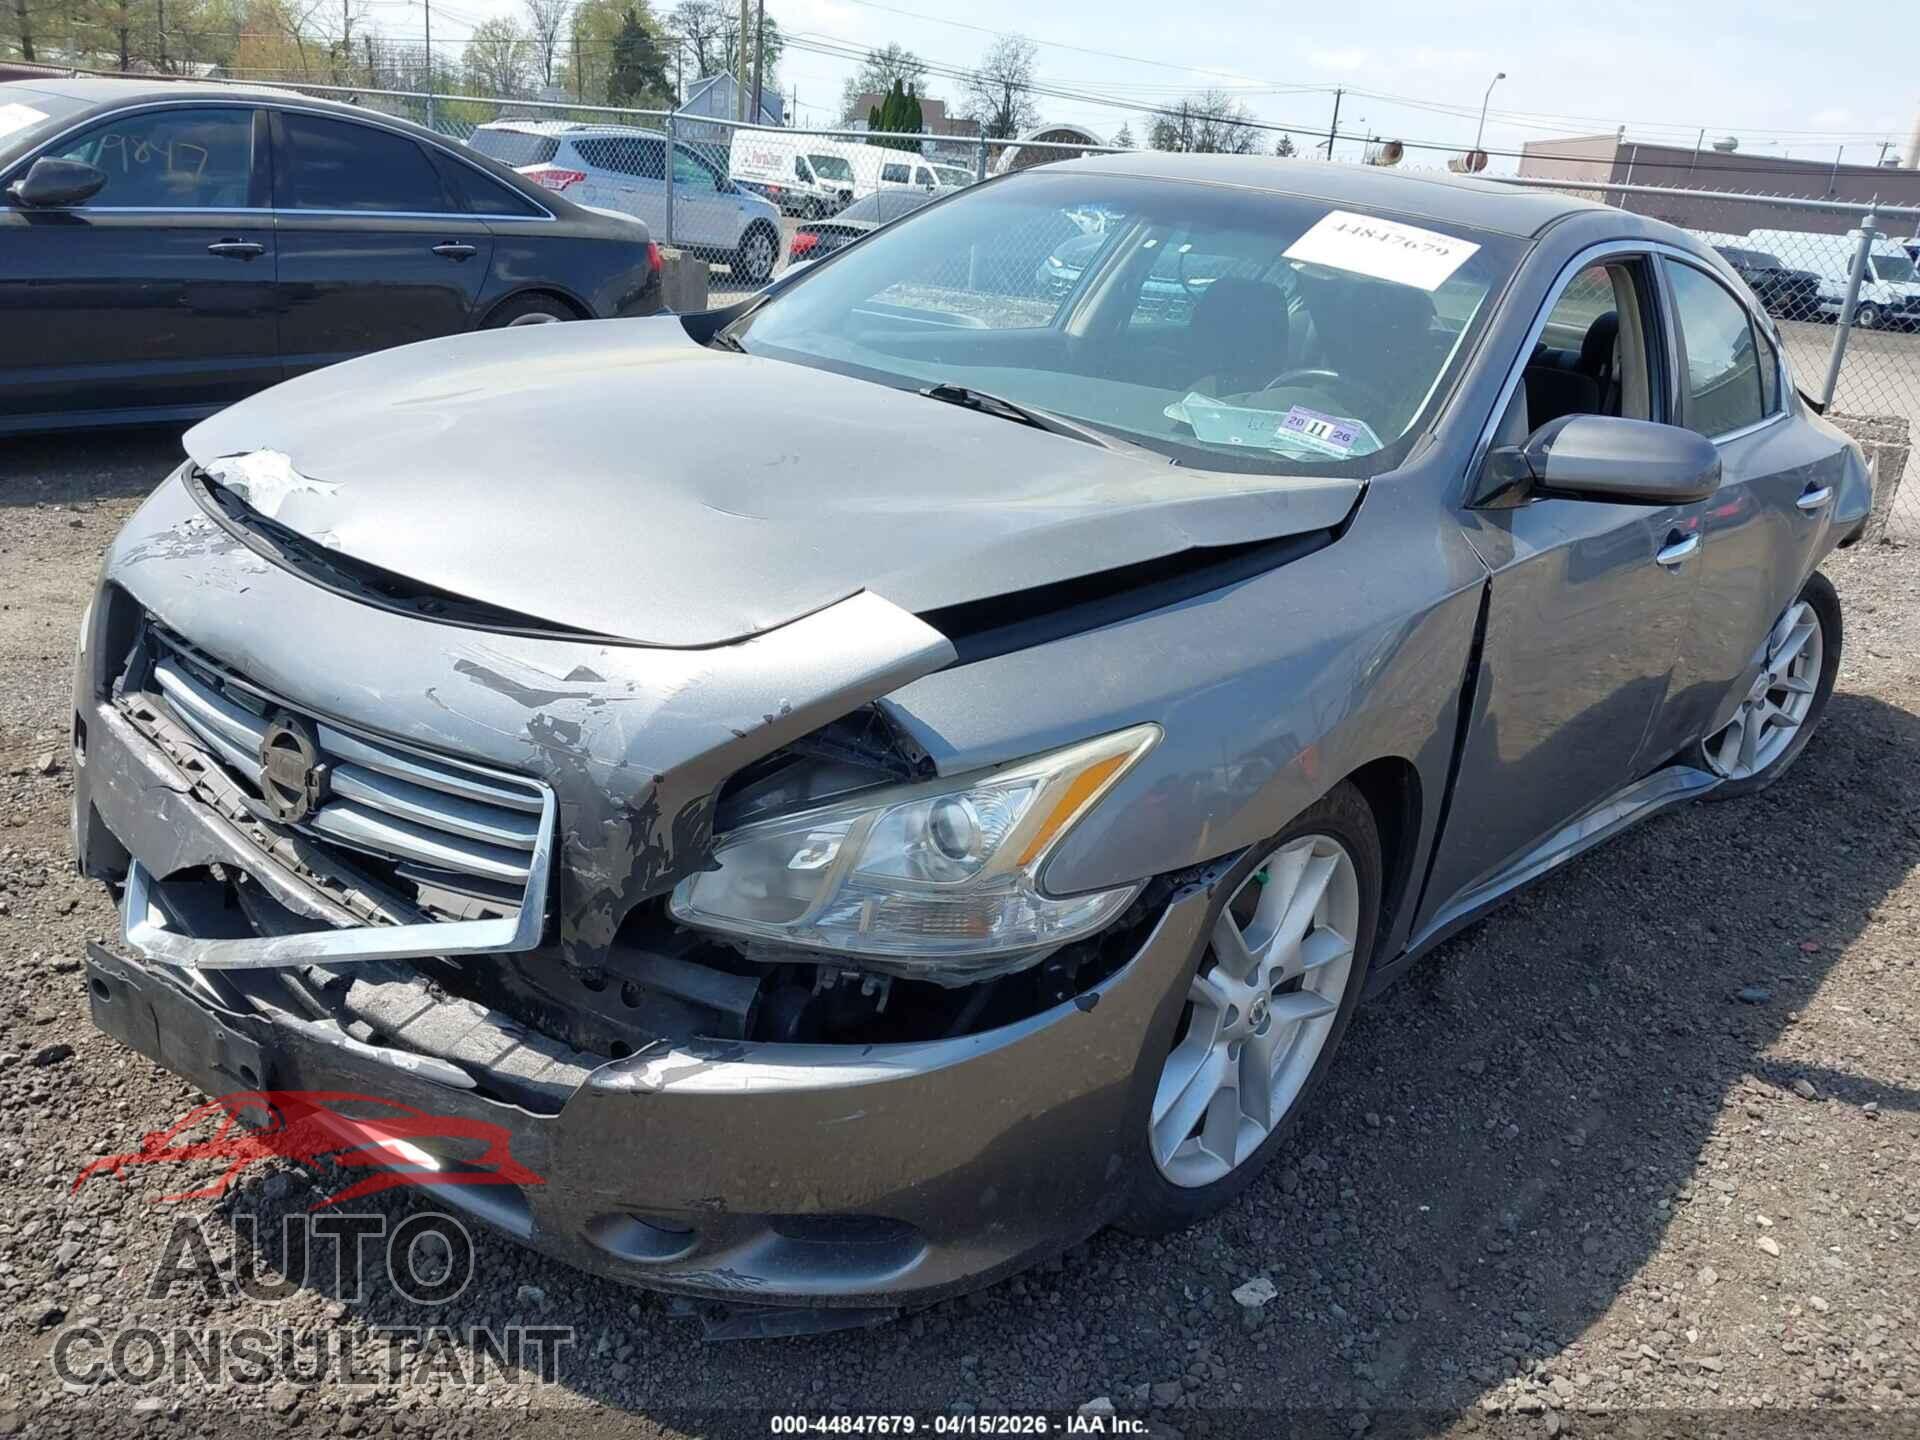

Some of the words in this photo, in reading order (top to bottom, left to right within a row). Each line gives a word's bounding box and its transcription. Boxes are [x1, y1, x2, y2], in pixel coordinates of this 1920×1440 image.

[1287, 415, 1305, 427] 20
[1307, 421, 1328, 437] 11
[1332, 430, 1352, 442] 26
